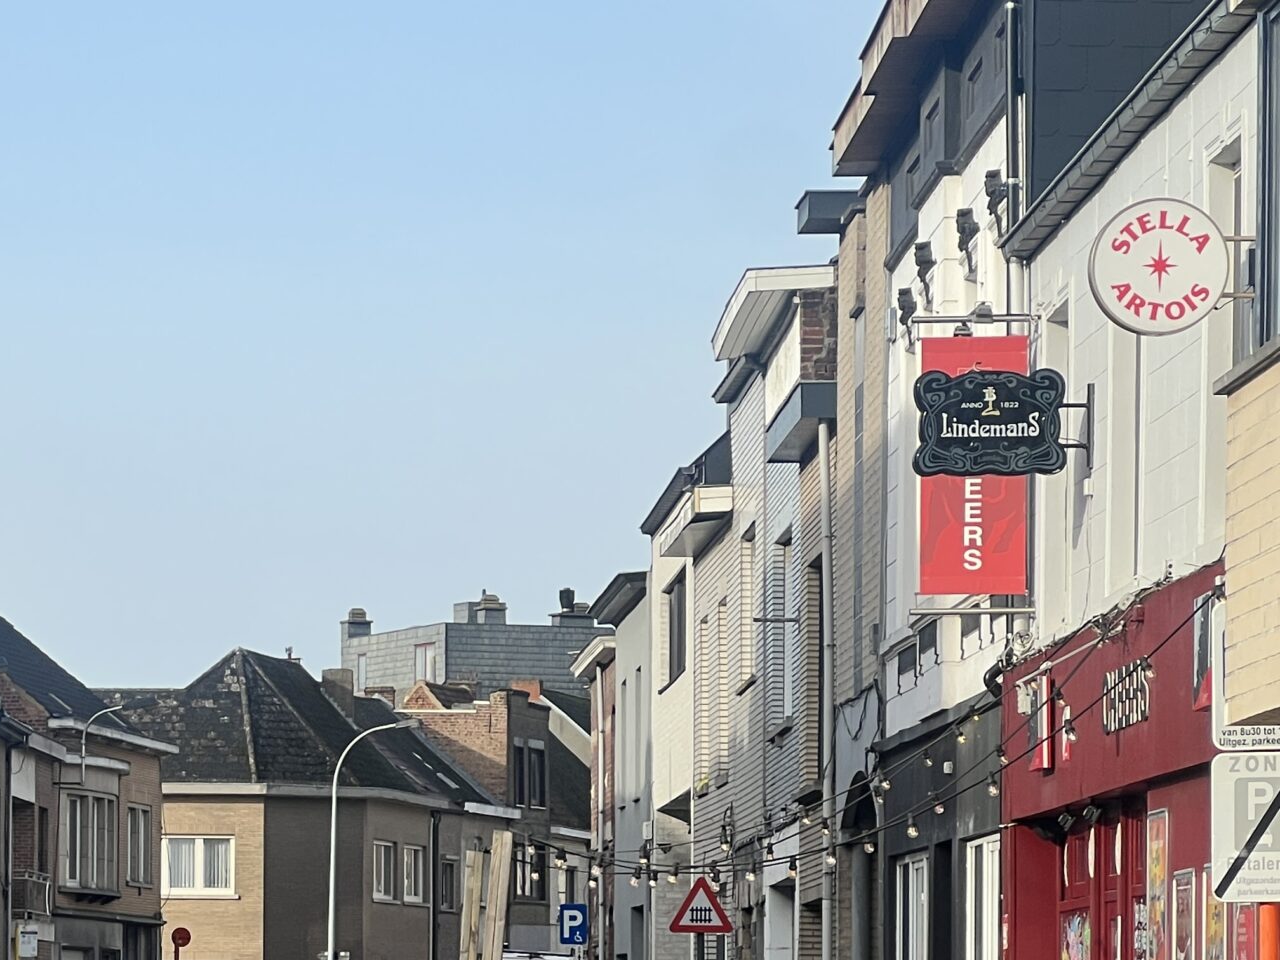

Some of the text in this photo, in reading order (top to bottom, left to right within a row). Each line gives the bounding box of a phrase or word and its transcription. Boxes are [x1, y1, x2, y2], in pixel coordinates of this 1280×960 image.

[1111, 210, 1212, 256] STELLA
[1110, 282, 1211, 321] ARTOIS
[1240, 727, 1261, 736] 8u30
[1263, 727, 1276, 735] tot
[1228, 755, 1278, 773] ZON
[1247, 781, 1274, 821] P
[563, 909, 584, 939] P
